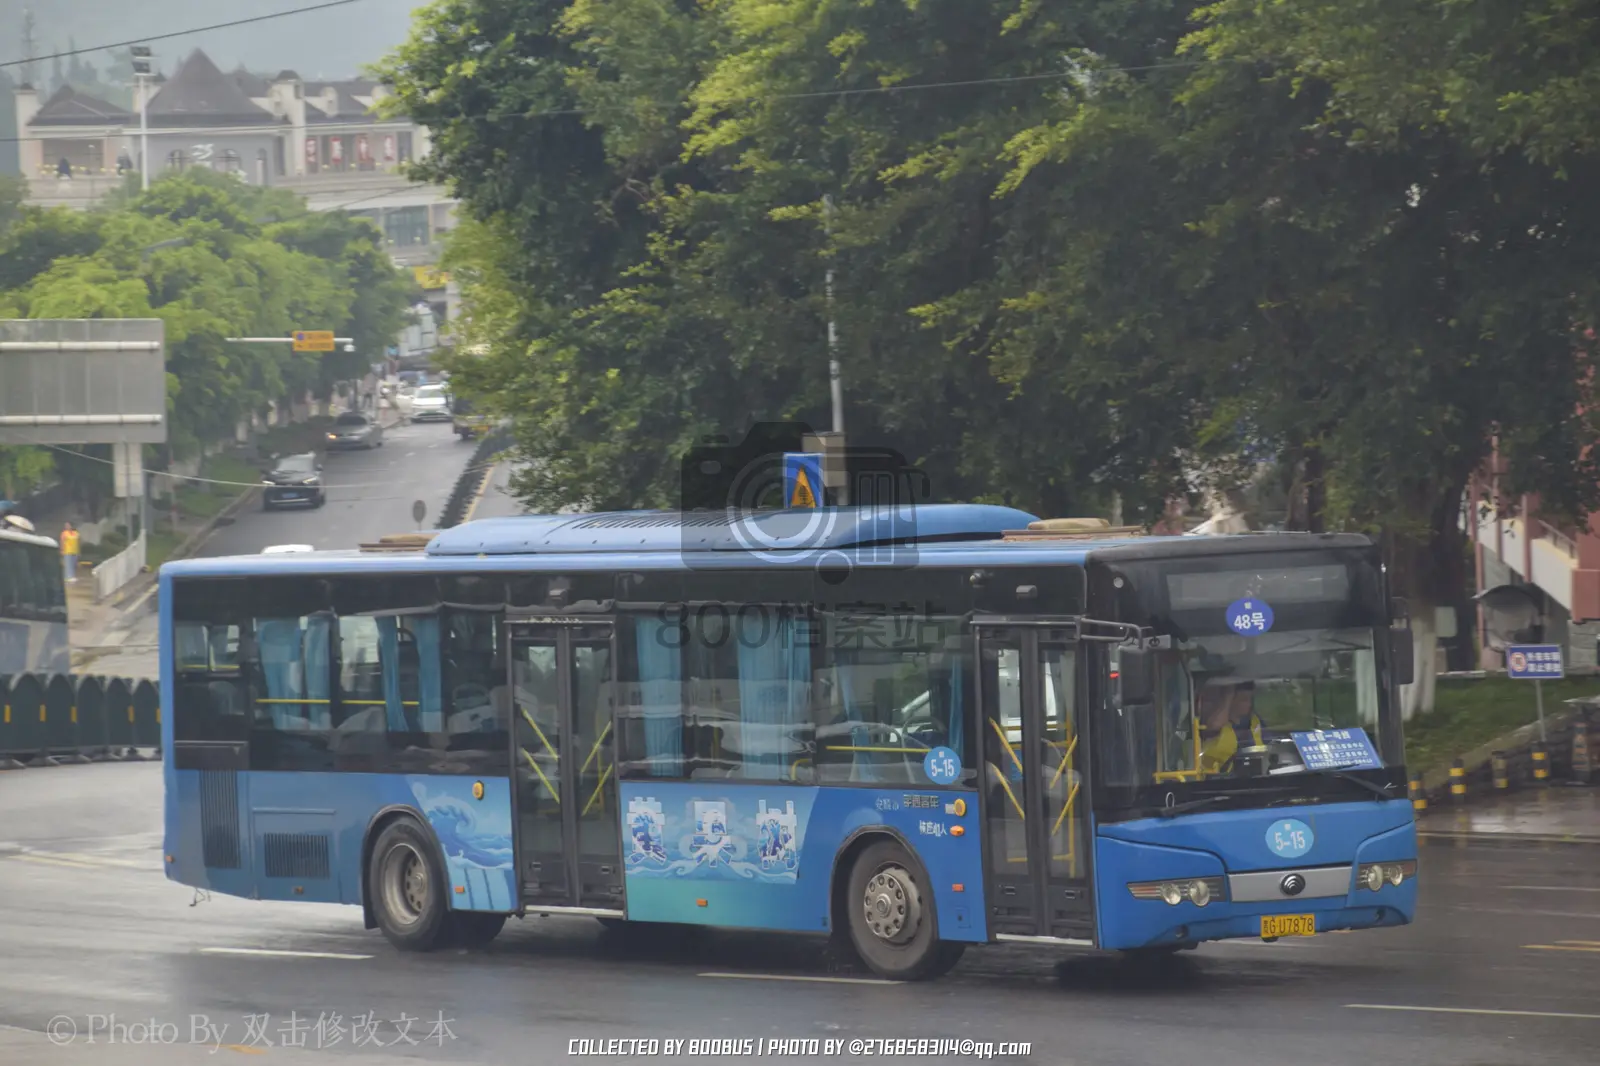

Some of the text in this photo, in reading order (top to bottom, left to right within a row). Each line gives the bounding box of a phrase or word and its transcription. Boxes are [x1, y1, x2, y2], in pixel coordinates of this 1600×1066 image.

[1233, 611, 1266, 632] 48号
[931, 759, 954, 776] 5-15
[1274, 831, 1305, 850] 5-15
